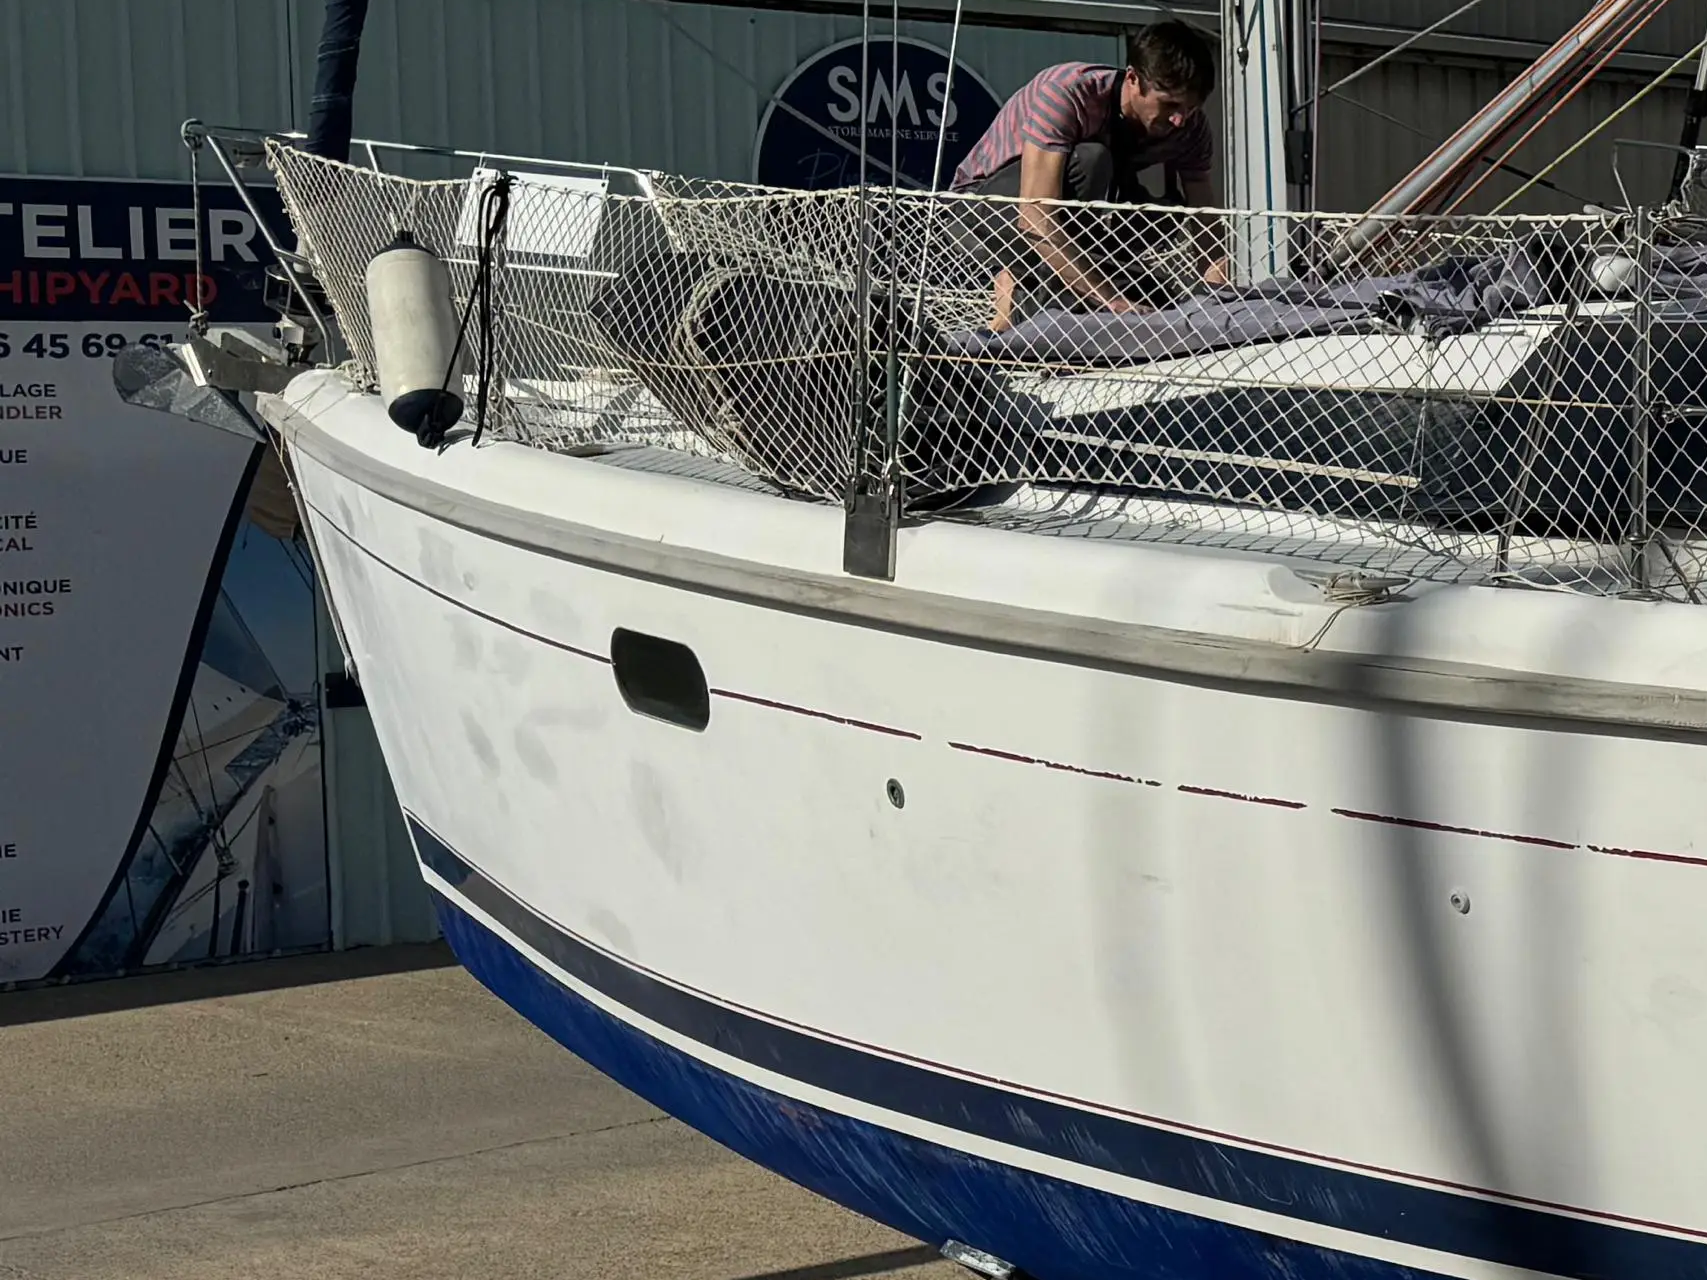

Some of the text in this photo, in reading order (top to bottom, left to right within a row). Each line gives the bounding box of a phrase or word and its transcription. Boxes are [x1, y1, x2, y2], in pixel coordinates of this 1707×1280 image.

[826, 65, 958, 127] SMS
[867, 127, 912, 141] MARNE
[22, 333, 70, 359] 45
[82, 333, 127, 358] 69
[0, 405, 63, 420] DLER
[0, 579, 71, 595] NIQUE
[0, 602, 54, 617] NICS
